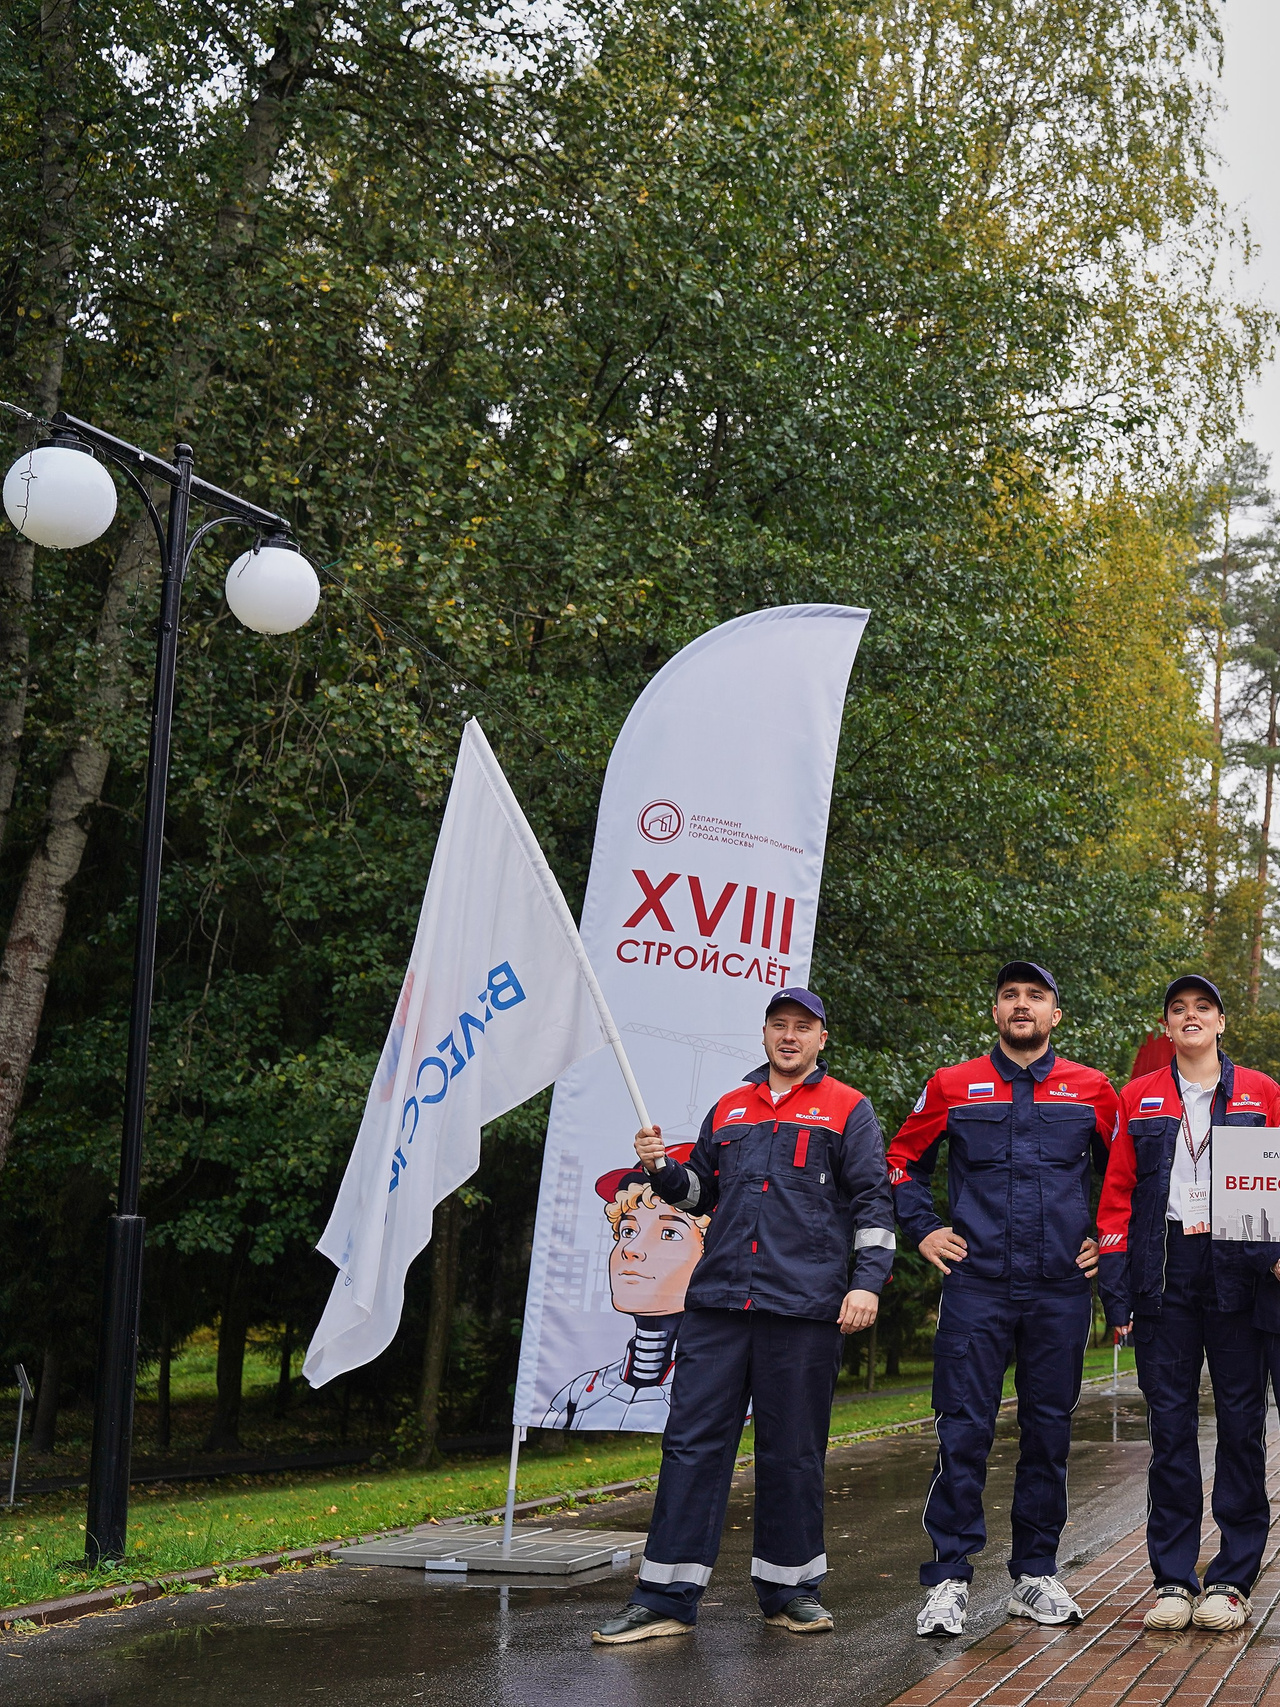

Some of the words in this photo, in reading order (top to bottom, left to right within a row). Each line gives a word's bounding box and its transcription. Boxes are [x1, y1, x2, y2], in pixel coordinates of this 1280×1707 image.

[690, 814, 742, 829] ДЕПАРТАМЕНТ
[688, 831, 720, 842] ГОРОДА
[721, 837, 755, 849] МОСКВЫ
[689, 822, 769, 844] ГРАДОСТРОИТЕЛЬНОЙ
[769, 839, 804, 855] ПОЛИТИКИ
[622, 869, 795, 955] XVIII
[616, 939, 790, 988] СТРОЙСЛЁТ
